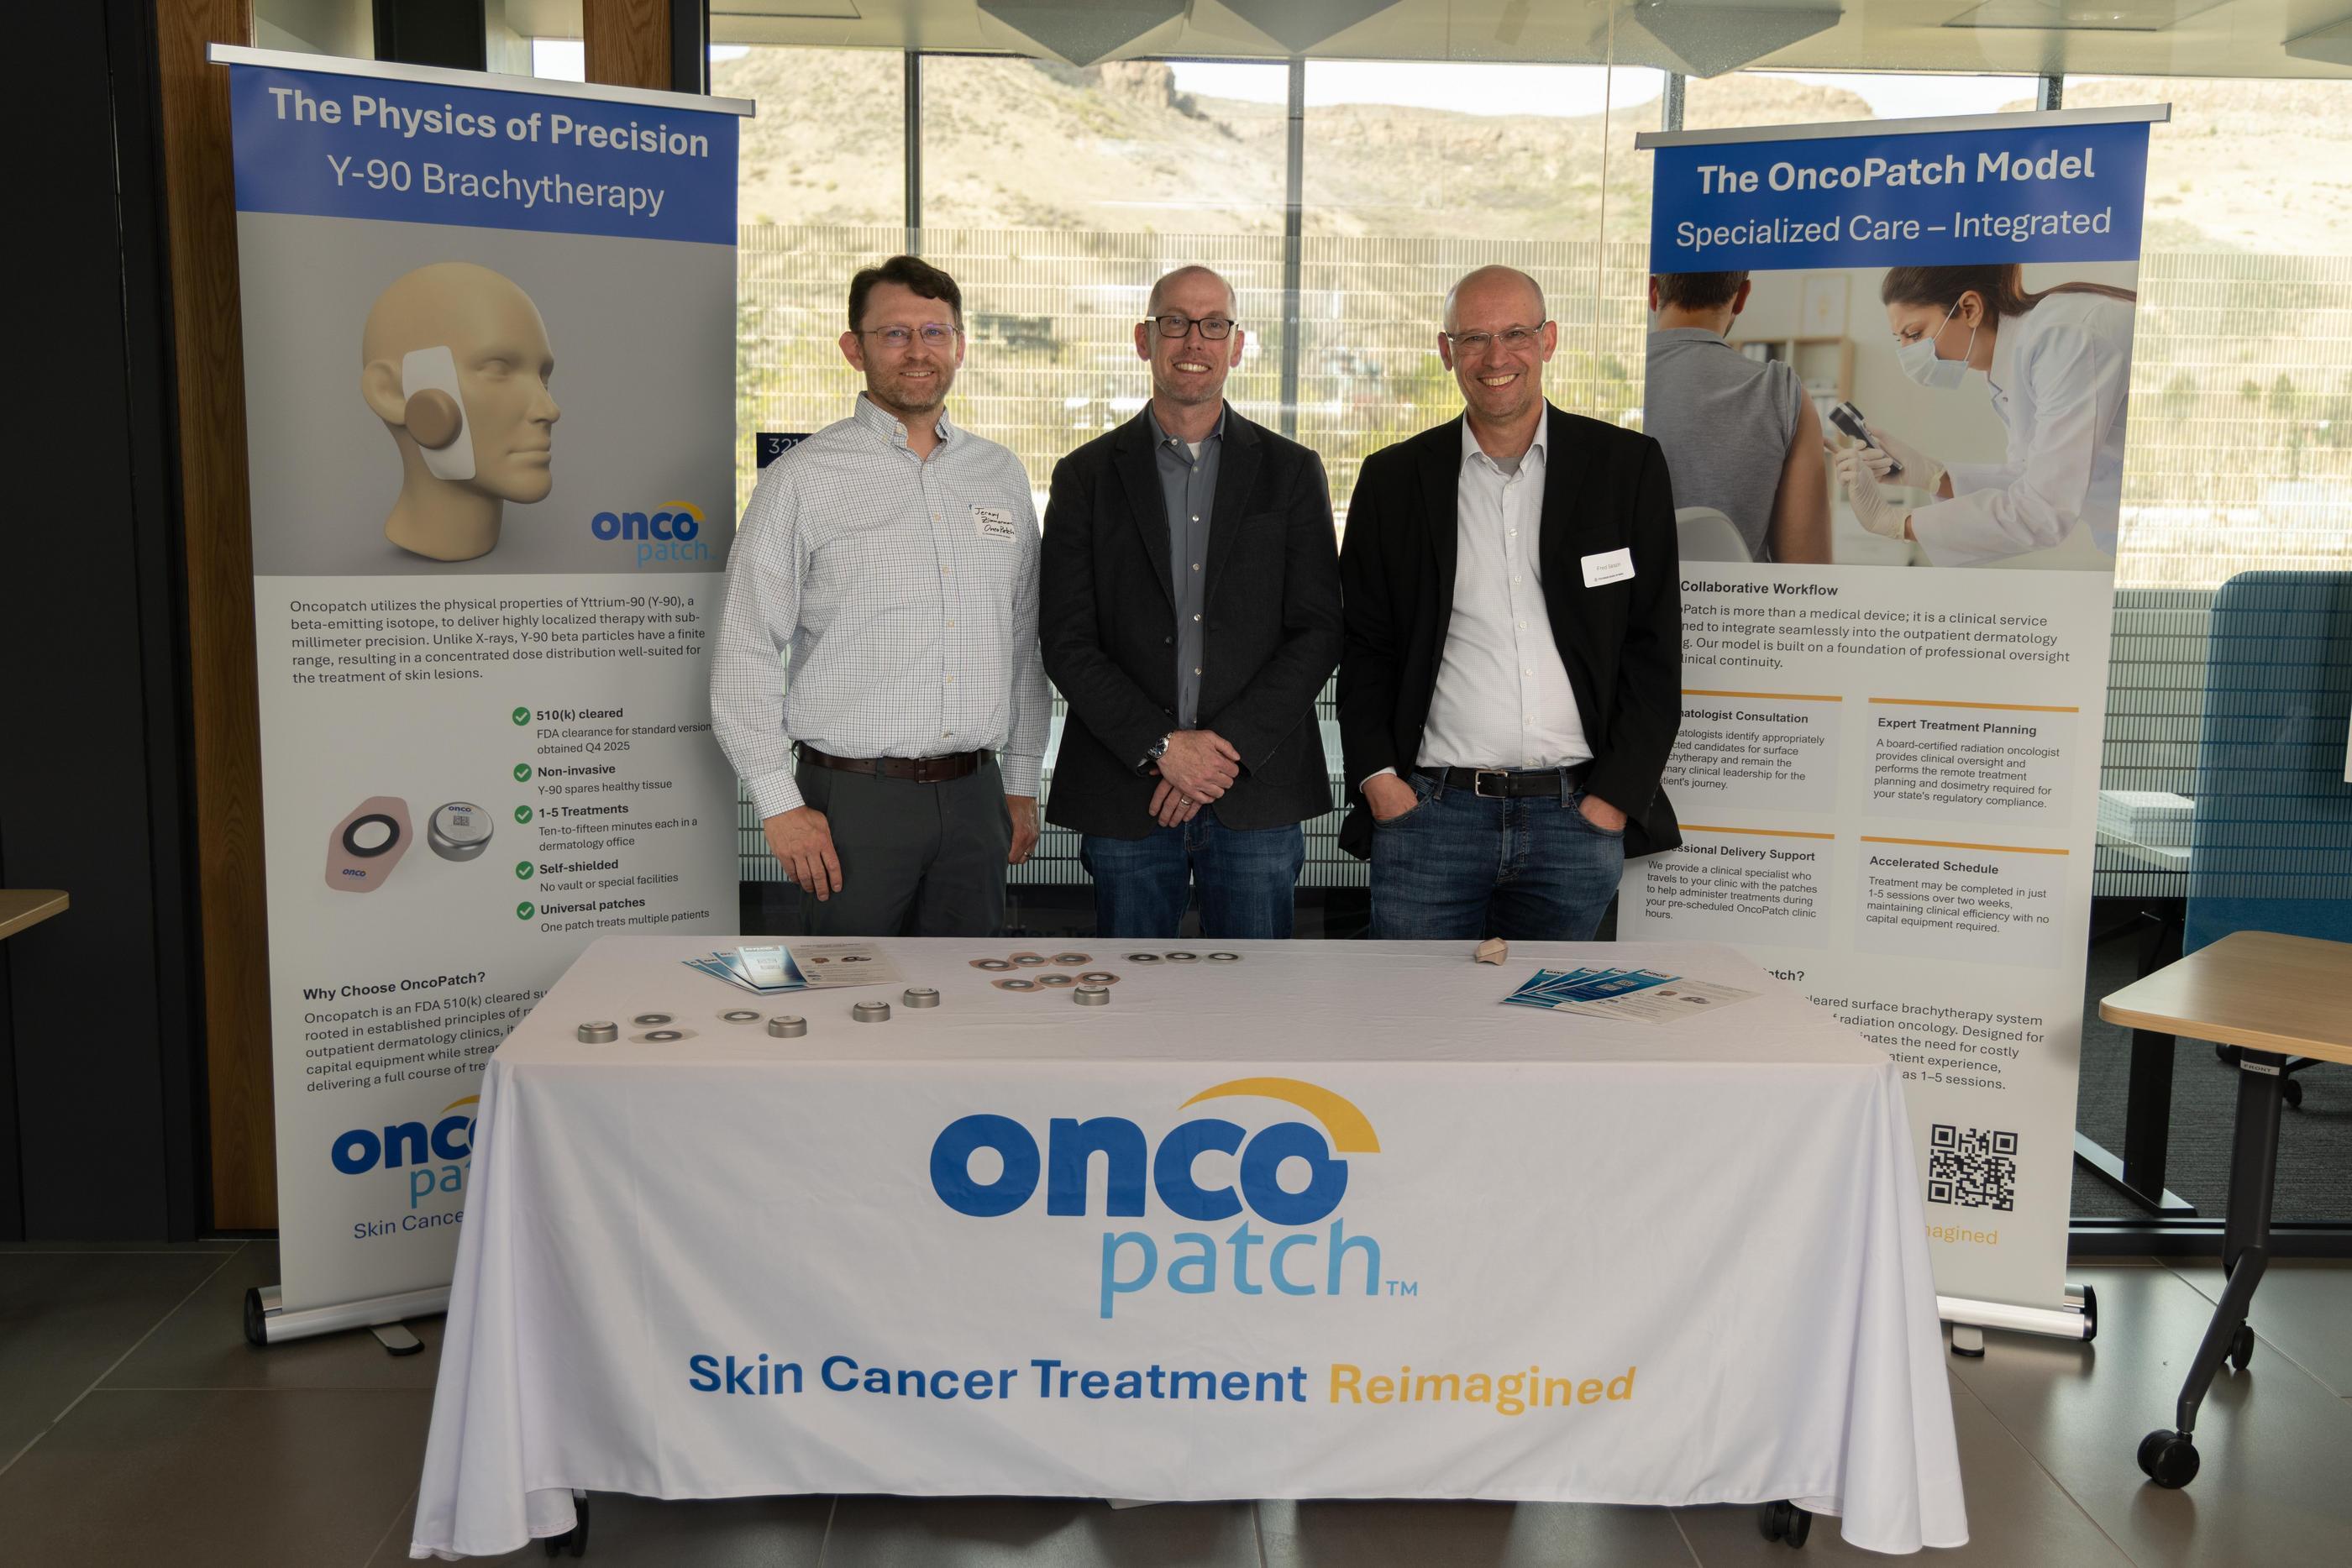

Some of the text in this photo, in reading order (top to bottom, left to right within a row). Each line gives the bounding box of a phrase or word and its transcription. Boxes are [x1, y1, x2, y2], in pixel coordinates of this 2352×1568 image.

[268, 87, 707, 157] The Physics of Precision
[1697, 147, 2094, 194] The OncoPatch Model
[327, 155, 664, 217] Y-90 Brachytherapy
[1677, 216, 1840, 252] Specialized
[1849, 215, 1919, 240] Care
[1955, 207, 2110, 242] Integrated
[591, 511, 699, 542] onco
[636, 540, 708, 569] patch
[1680, 579, 1838, 596] Collaborative Workflow
[290, 600, 366, 614] Oncopatch
[370, 600, 416, 611] utilizes
[419, 600, 440, 610] the
[444, 598, 496, 611] physical
[500, 598, 562, 611] properties
[566, 597, 578, 607] of
[580, 596, 644, 607] Yttrium-90
[648, 596, 684, 608] (Y-90),
[291, 612, 699, 631] beta-emitting isotope, to deliver highly localized therapy with sub-
[1720, 605, 1730, 615] is
[1733, 608, 1764, 616] more
[1768, 607, 1795, 617] than
[1810, 609, 1860, 619] medical
[1864, 610, 1908, 622] device;
[1913, 611, 1921, 621] it
[1924, 611, 1935, 622] is
[1949, 612, 1996, 624] clinical
[2000, 615, 2046, 626] service
[537, 707, 622, 721] 510(k) cleared
[1735, 711, 1808, 723] Consultation
[537, 722, 711, 738] FDA clearance for standard version
[1878, 717, 2036, 737] Expert Treatment Planning
[537, 741, 629, 754] obtained Q4 2025
[1876, 738, 2059, 758] A board-certified radiation oncologist
[1876, 752, 2025, 768] provides clinical oversight and
[538, 764, 615, 777] Non-invasive
[1875, 764, 2026, 780] performs the remote treatment
[538, 780, 672, 795] Y-90 spares healthy tissue
[1874, 776, 2051, 794] planning and dosimetry required for
[1873, 790, 2046, 807] your state's regulatory compliance.
[539, 805, 628, 817] 1-5 Treatments
[538, 824, 608, 836] Ten-to-fifteen
[612, 821, 652, 831] minutes
[654, 819, 678, 828] each
[681, 818, 689, 826] in
[539, 836, 634, 851] dermatology office
[1720, 846, 1814, 862] Delivery Support
[343, 868, 366, 877] onco
[539, 859, 617, 873] Self-shielded
[1869, 856, 1998, 874] Accelerated Schedule
[540, 883, 554, 892] No
[558, 880, 582, 890] vault
[598, 876, 634, 889] special
[637, 873, 678, 884] facilities
[541, 898, 645, 915] Universal patches
[541, 910, 709, 932] One patch treats multiple patients
[302, 972, 485, 1001] Why Choose OncoPatch?
[1851, 1000, 2042, 1025] surface brachytherapy system
[1840, 1015, 2044, 1042] radiation oncology. Designed for
[1901, 1036, 2019, 1059] the need for costly
[1928, 1057, 2000, 1073] experience,
[1902, 1071, 1916, 1079] as
[1945, 1076, 2005, 1089] sessions.
[931, 1114, 1347, 1225] onco
[354, 1209, 464, 1240] Skin Cance
[1101, 1219, 1380, 1319] patch
[690, 1353, 1636, 1416] Skin Cancer Treatment Reimagined
